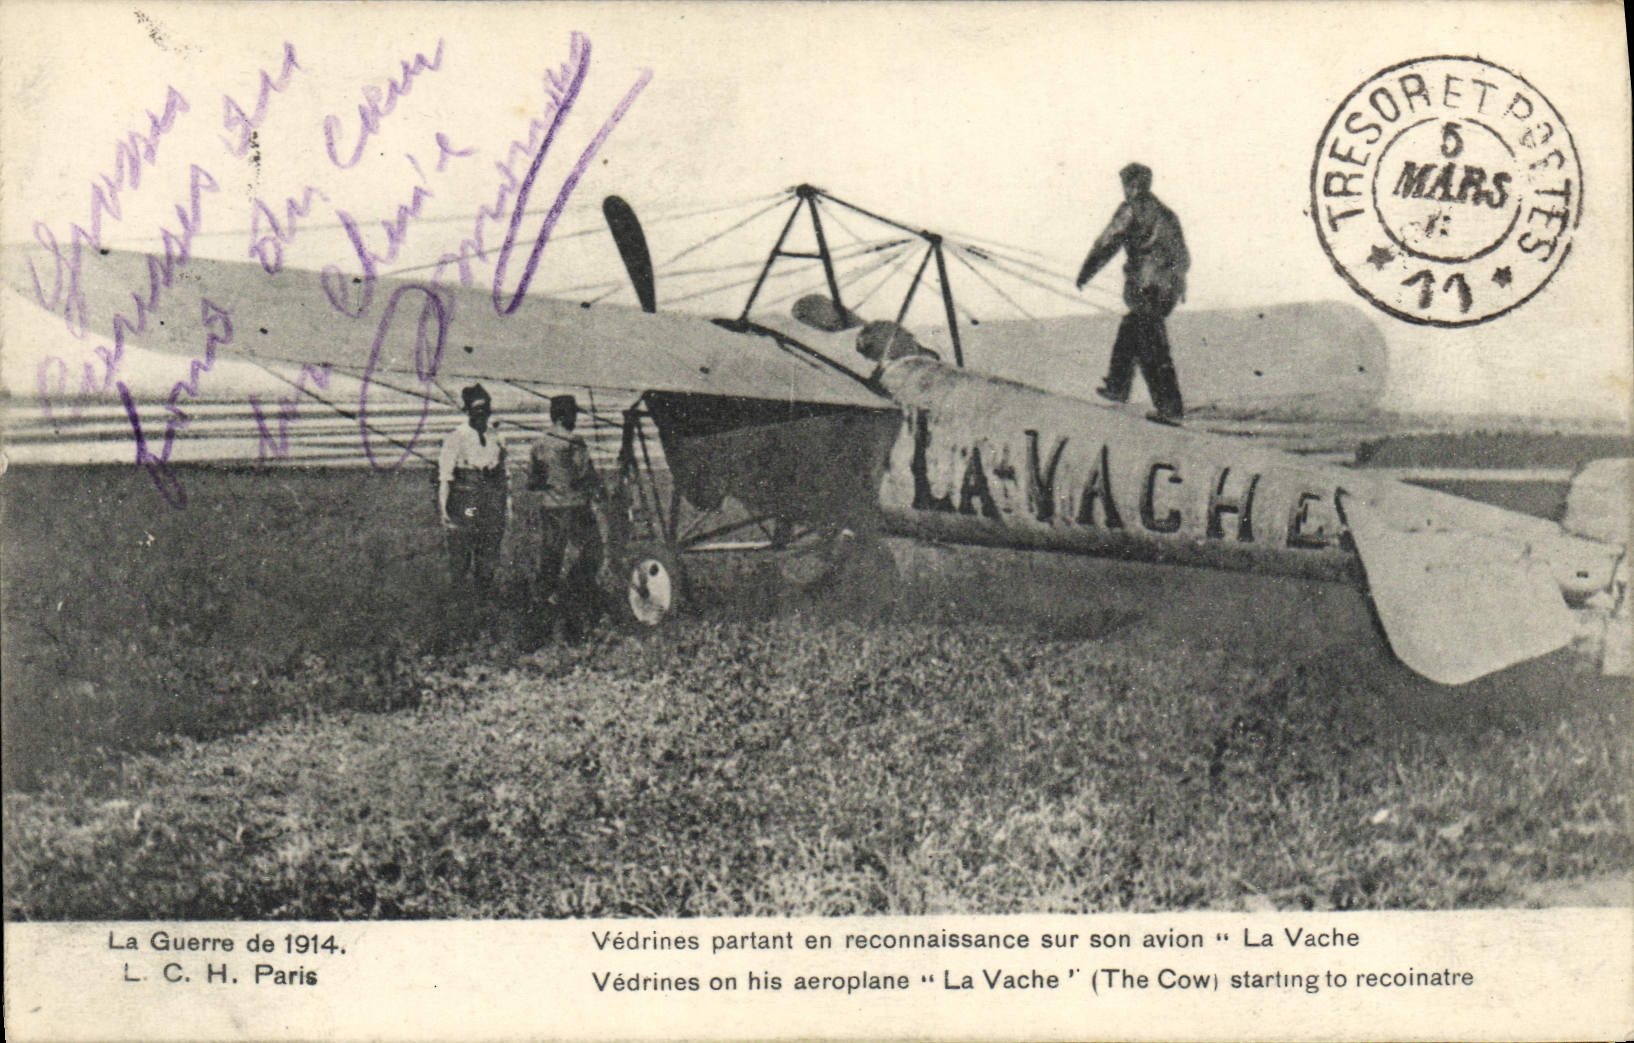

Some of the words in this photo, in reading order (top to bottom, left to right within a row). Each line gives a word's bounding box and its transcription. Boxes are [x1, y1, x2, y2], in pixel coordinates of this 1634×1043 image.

[1323, 72, 1431, 233] TRESOR
[1444, 72, 1499, 115] ET
[1440, 121, 1464, 159] 5
[1392, 160, 1513, 210] MARS
